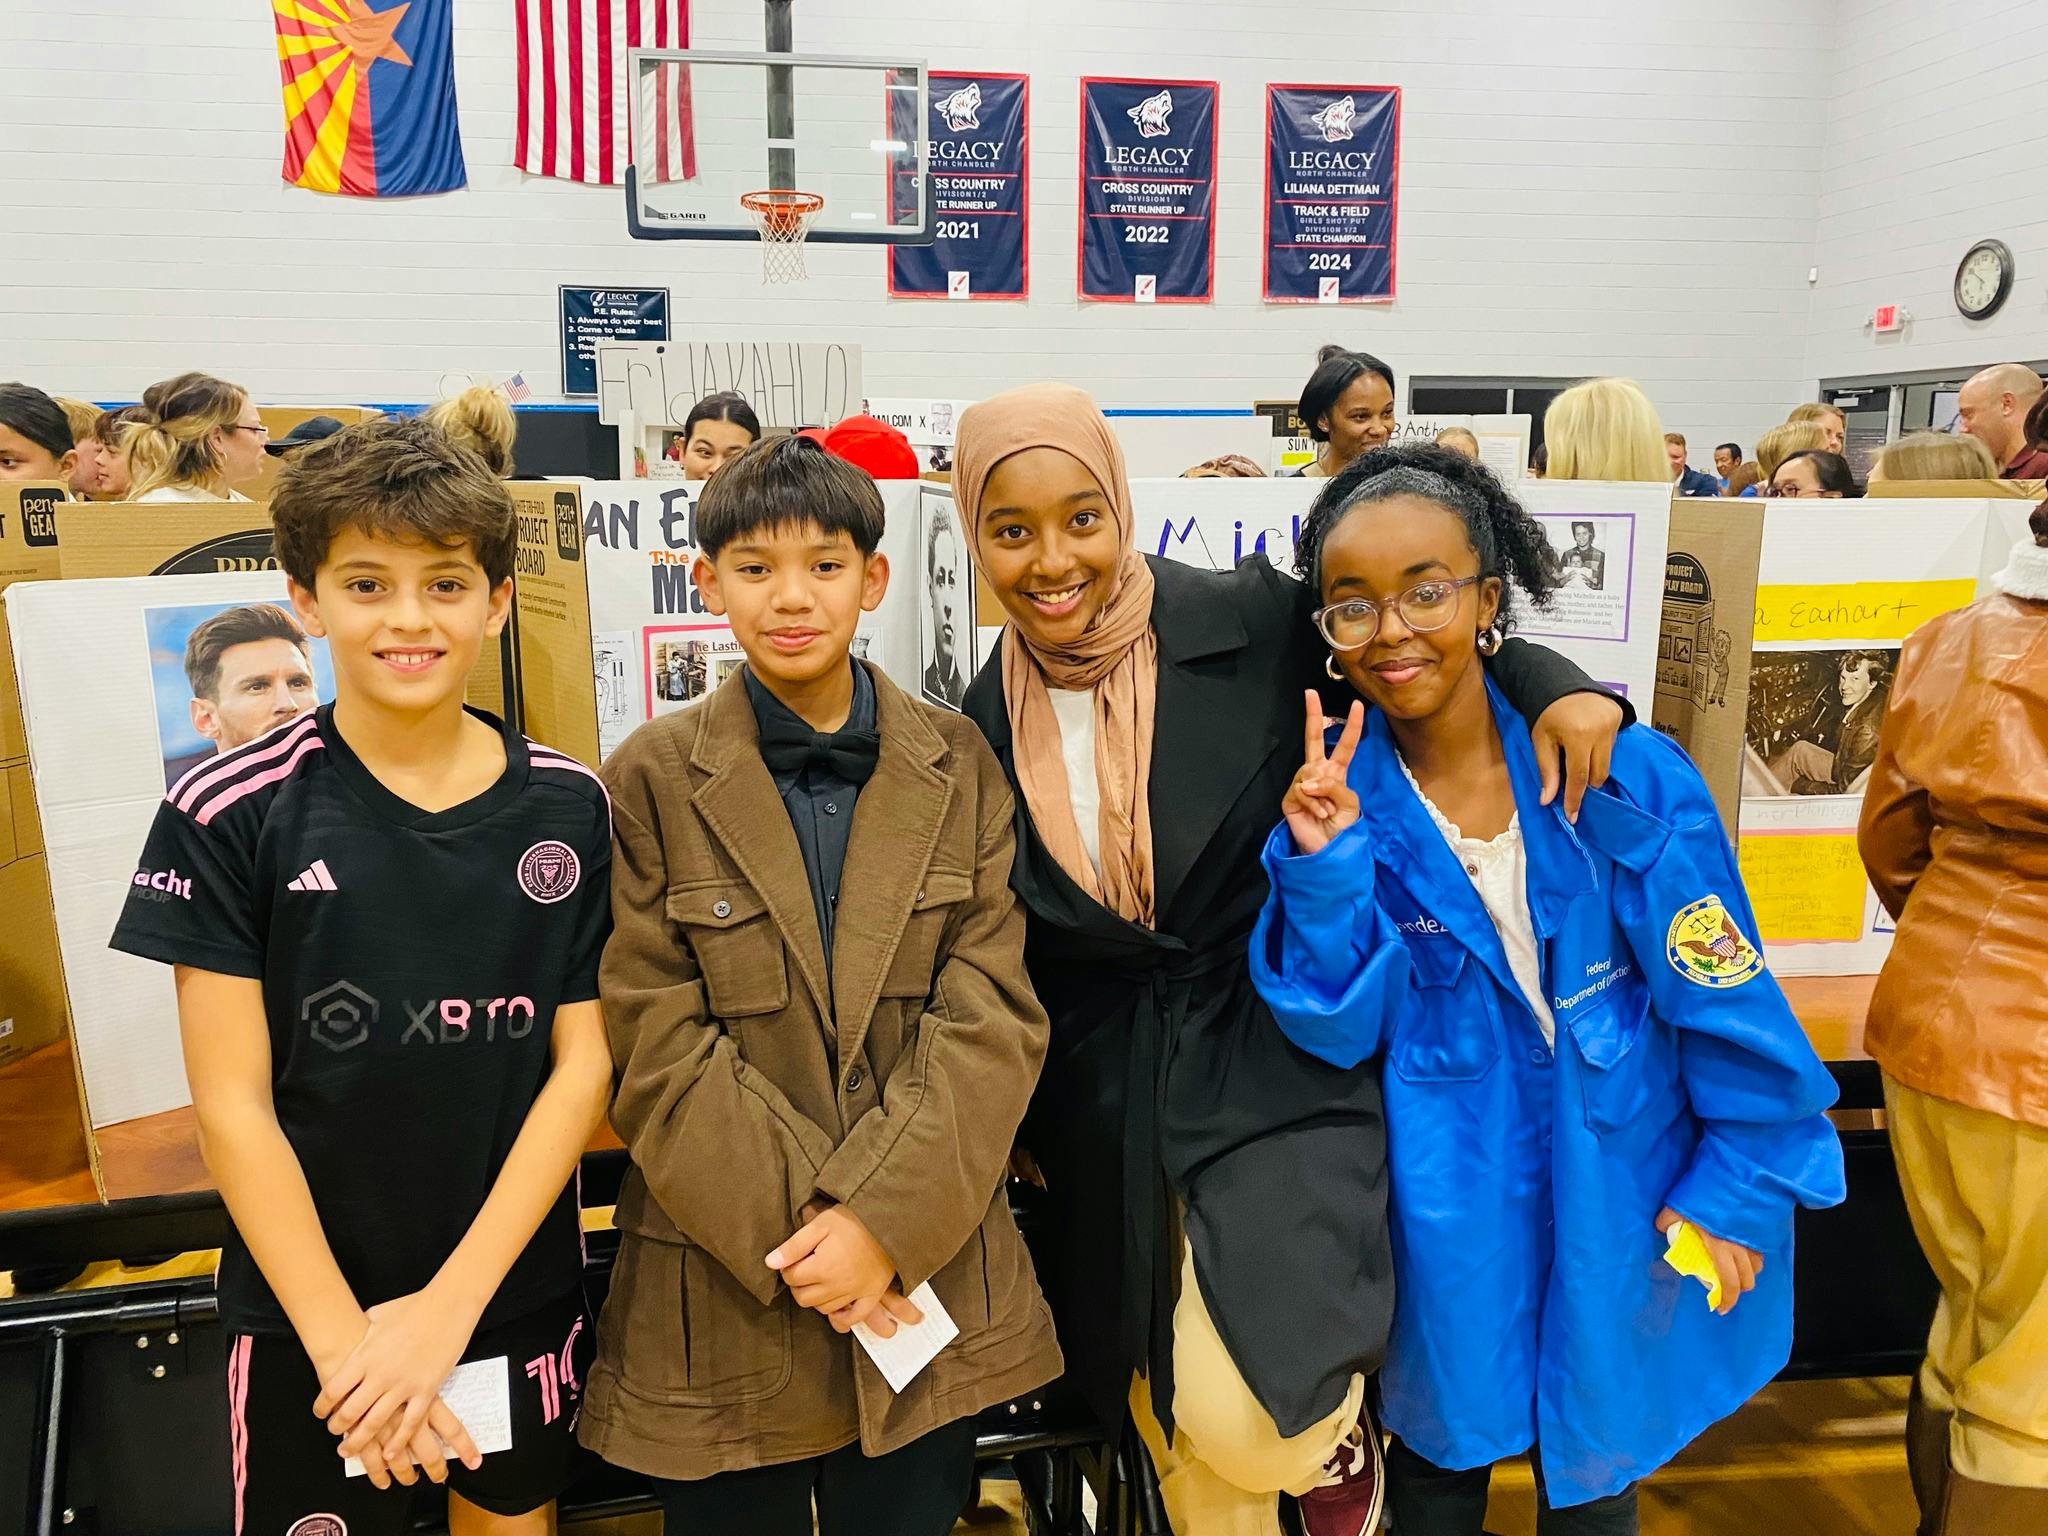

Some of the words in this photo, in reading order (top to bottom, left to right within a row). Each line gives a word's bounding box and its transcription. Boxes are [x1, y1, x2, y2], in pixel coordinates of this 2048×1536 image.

[1104, 146, 1194, 166] LEGACY
[1289, 151, 1377, 170] LEGACY
[951, 160, 996, 168] CHANDLER
[1111, 165, 1139, 173] NORTH
[1141, 166, 1185, 174] CHANDLER
[1325, 170, 1367, 178] CHANDLER
[951, 179, 1006, 191] COUNTRY
[1102, 182, 1140, 194] CROSS
[1141, 183, 1194, 196] COUNTRY
[1284, 183, 1325, 195] LILIANA
[1327, 184, 1380, 195] DETTMAN
[949, 200, 984, 210] RUNNER
[985, 201, 998, 210] UP
[1110, 204, 1137, 213] STATE
[1138, 205, 1173, 214] RUNNER
[1173, 206, 1186, 215] UP
[1293, 205, 1329, 217] TRACK
[1330, 206, 1339, 217] &
[1340, 206, 1370, 217] FIELD
[1299, 217, 1325, 225] GIRLS
[1325, 217, 1348, 225] SHOT
[935, 221, 979, 239] 2021
[1125, 225, 1169, 243] 2022
[1295, 234, 1322, 243] STATE
[1322, 234, 1367, 243] CHAMPION
[1309, 253, 1352, 270] 2024
[611, 308, 637, 317] Rules:
[568, 316, 576, 324] 1.
[577, 317, 609, 326] Always
[610, 317, 622, 325] do
[622, 318, 642, 326] your
[643, 318, 663, 326] best
[577, 326, 603, 334] Come
[614, 327, 637, 335] class
[568, 343, 578, 351] 3.
[919, 415, 927, 428] X
[1287, 438, 1308, 451] SUN
[559, 522, 577, 550] GEAR
[517, 547, 546, 577] BOARD
[649, 550, 690, 566] The
[1790, 598, 1920, 628] Earhart
[1585, 956, 1612, 977] Federal
[1597, 976, 1607, 992] of
[400, 995, 536, 1045] XBTO
